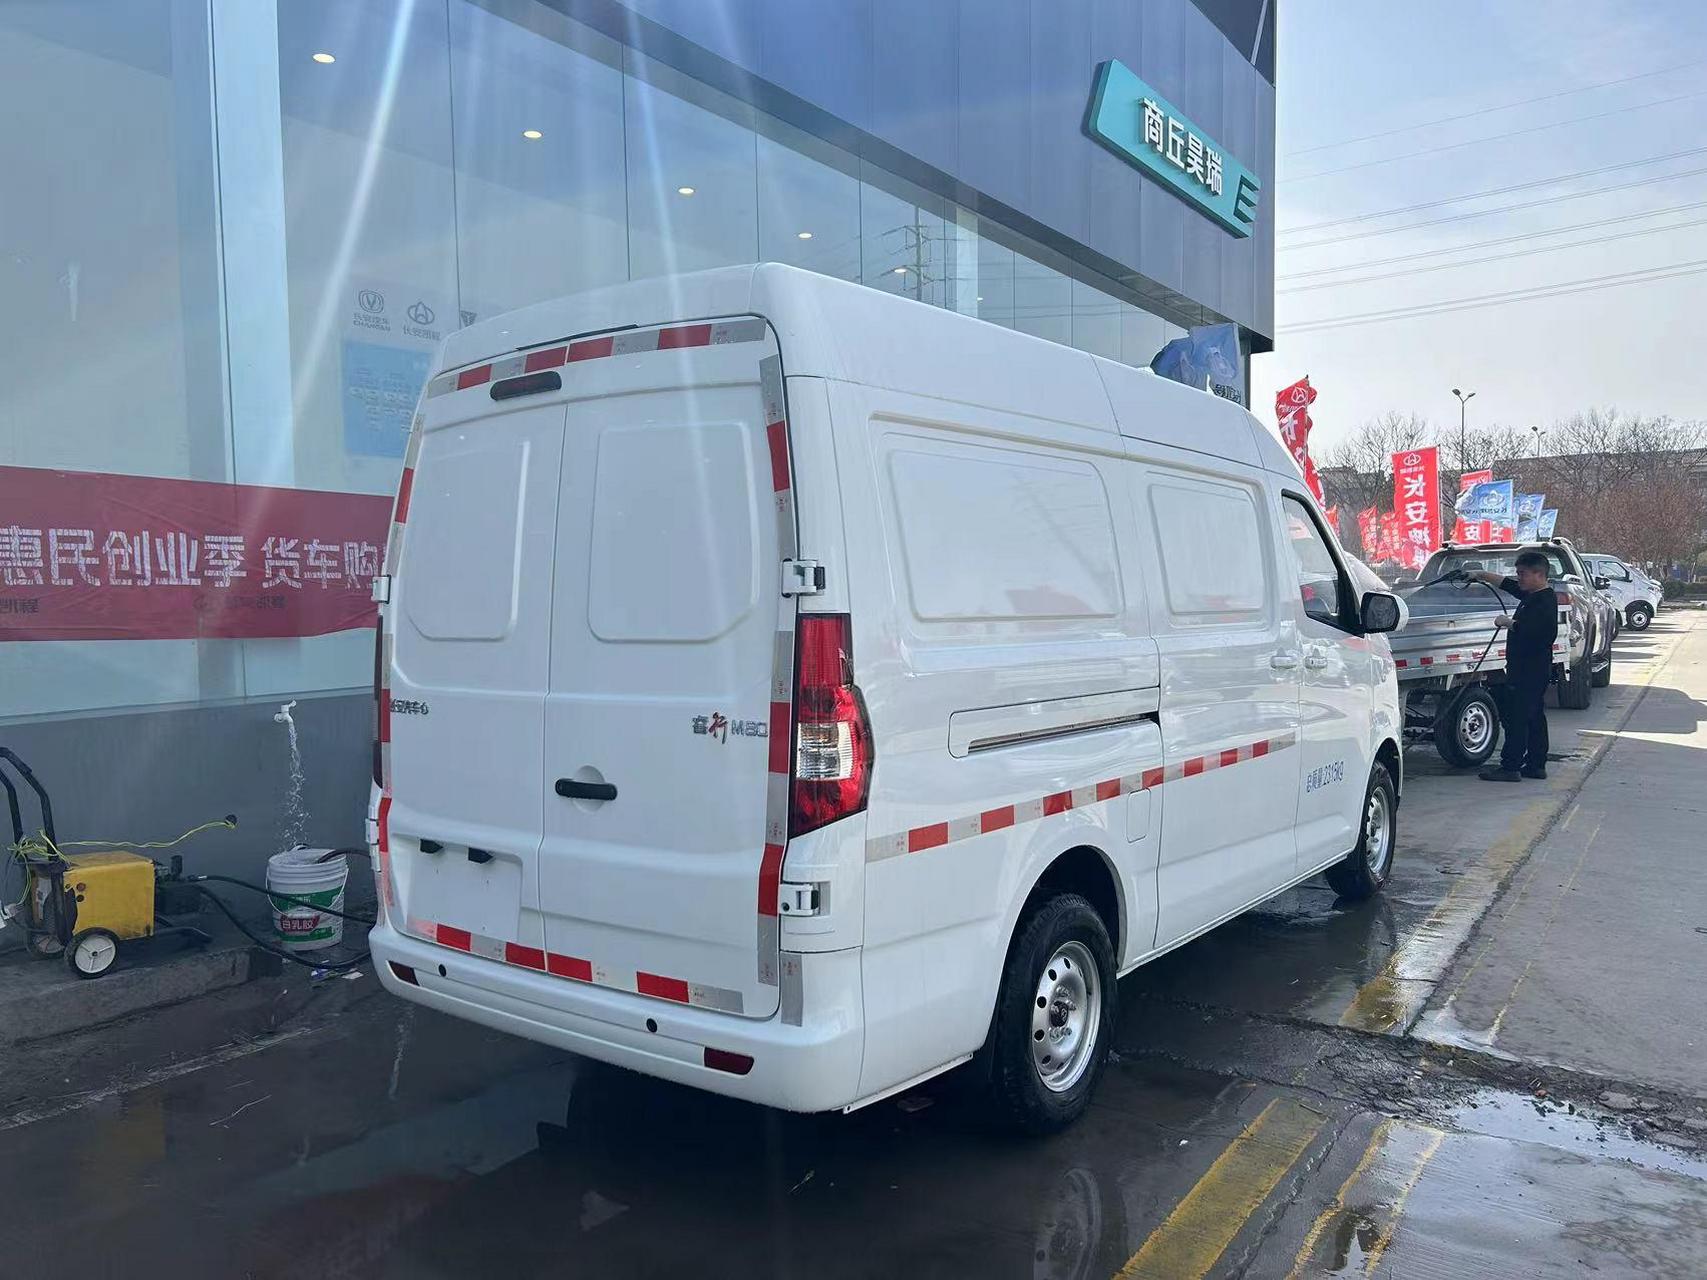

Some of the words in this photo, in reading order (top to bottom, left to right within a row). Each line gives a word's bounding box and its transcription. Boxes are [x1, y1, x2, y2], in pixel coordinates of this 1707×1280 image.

[1140, 97, 1223, 196] 商丘昊瑞
[0, 525, 248, 588] 惠民创业季
[261, 535, 387, 590] 货车购
[282, 919, 314, 930] 白乳胶
